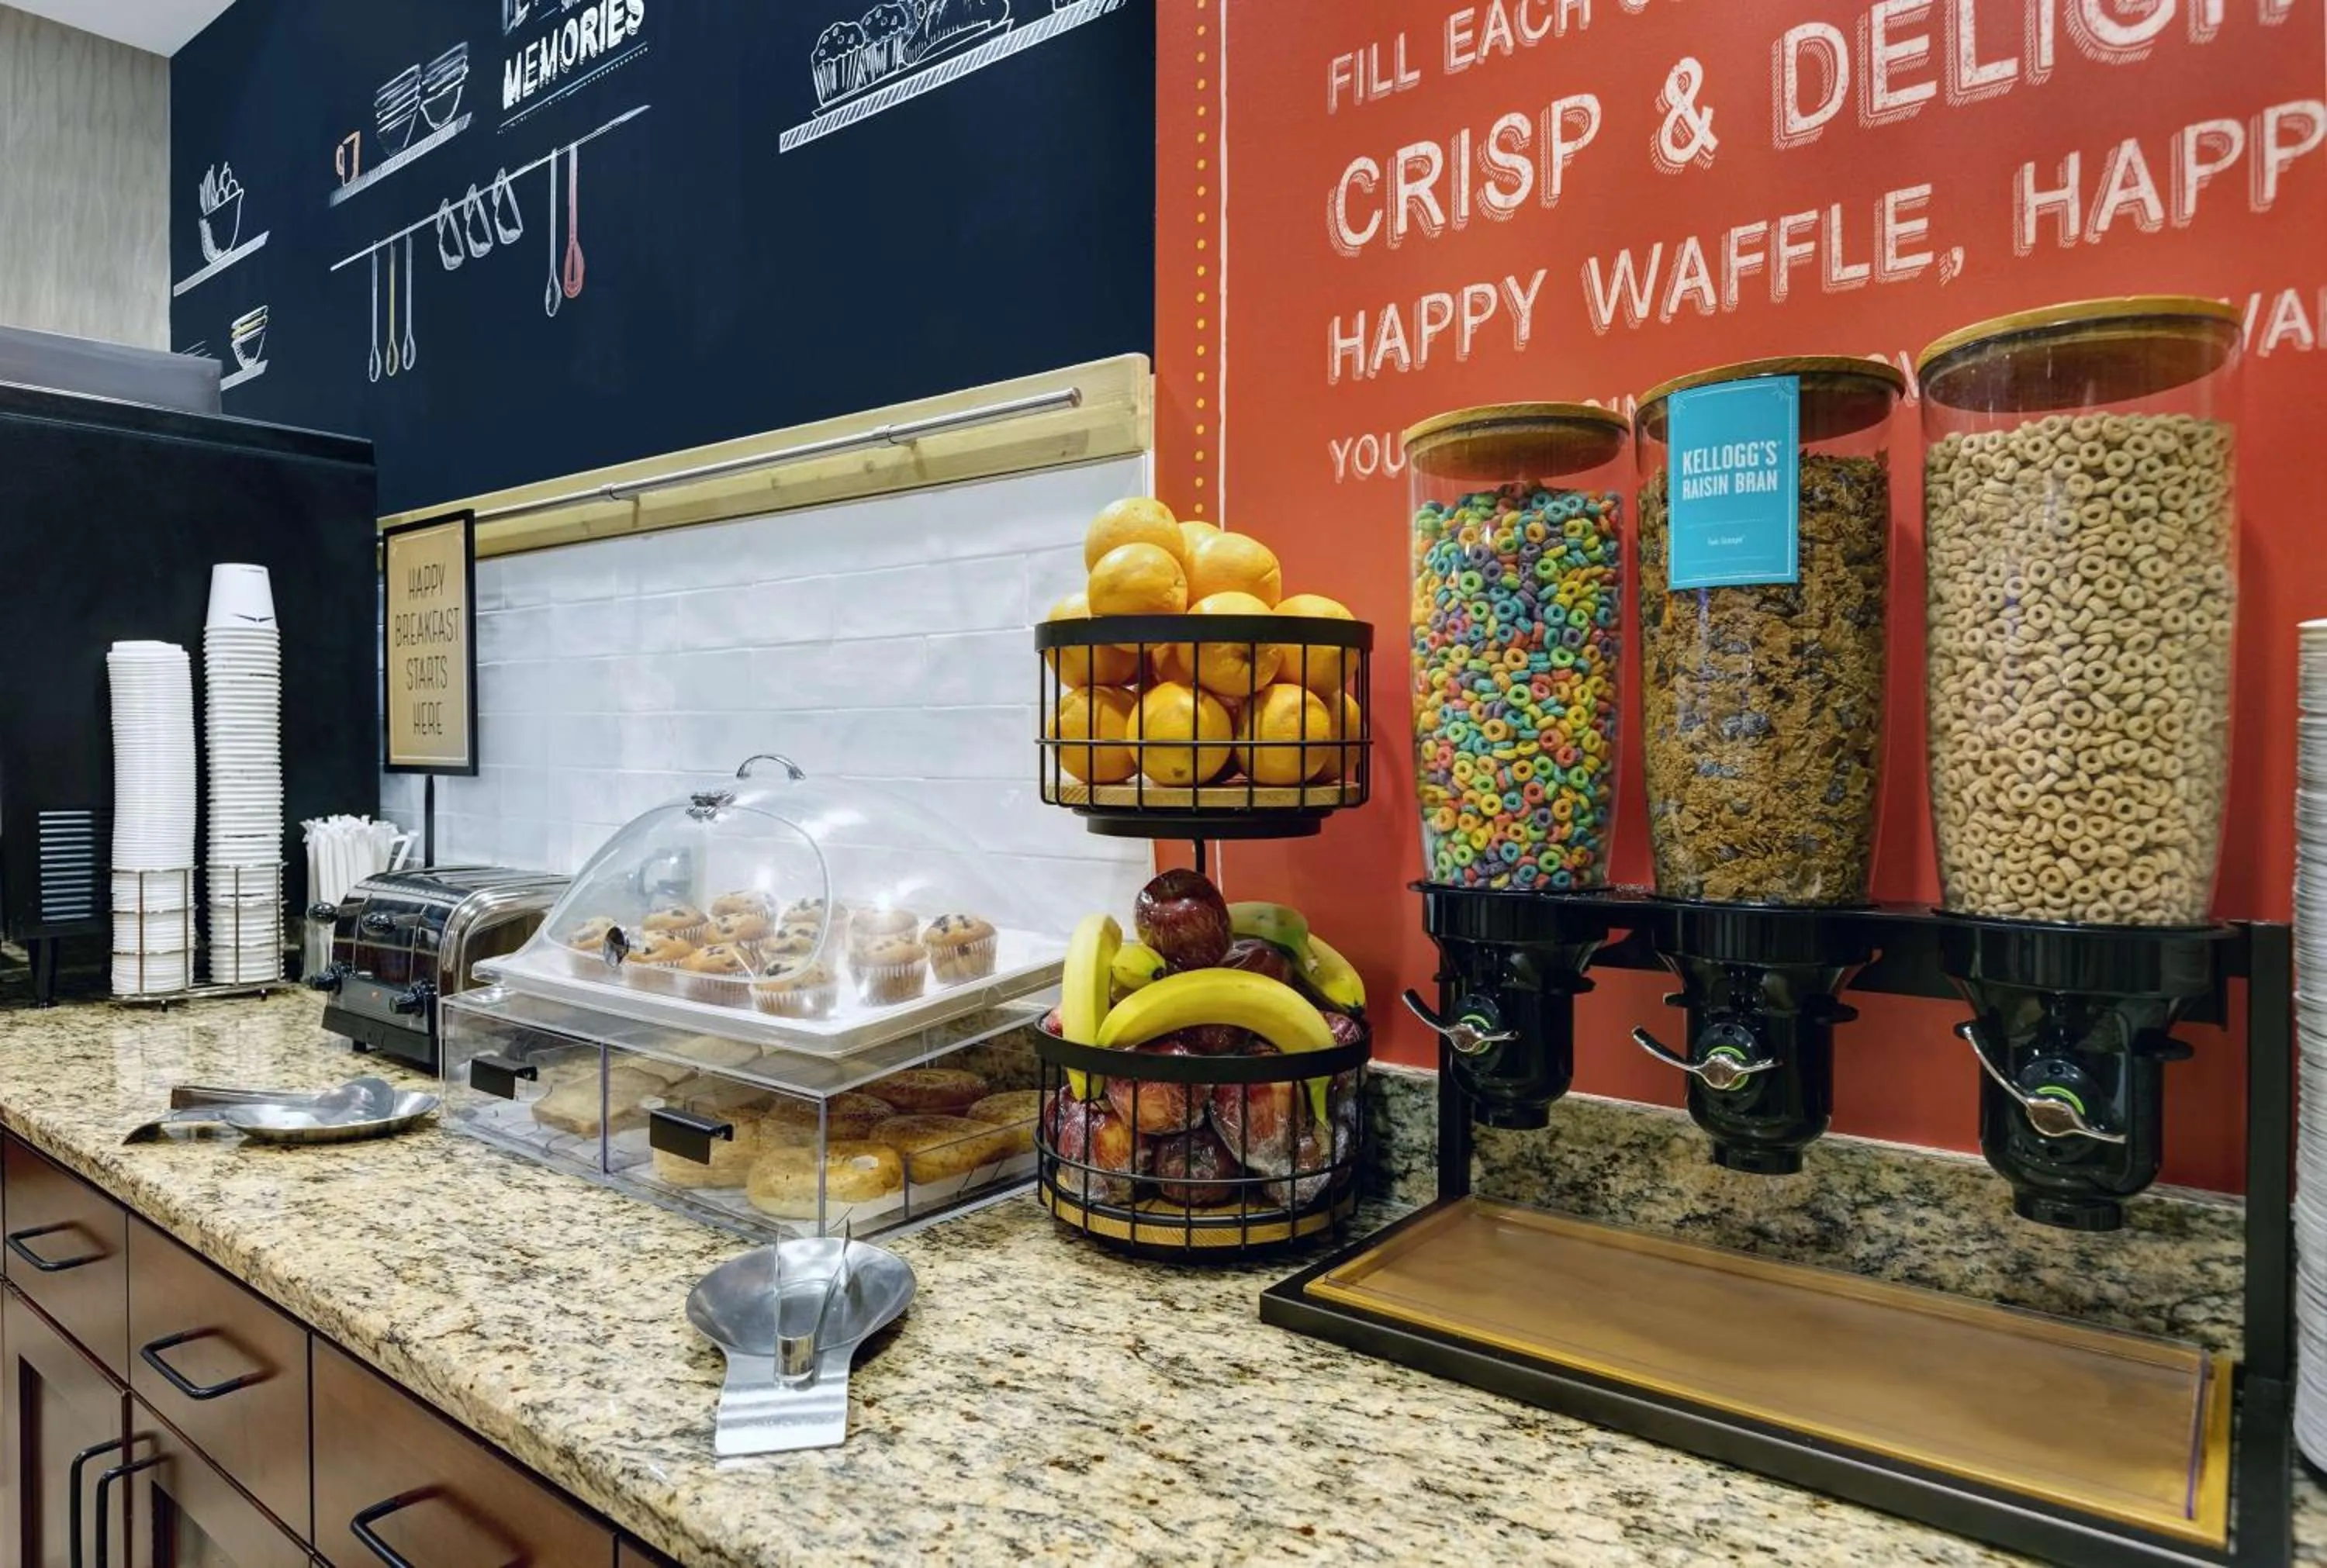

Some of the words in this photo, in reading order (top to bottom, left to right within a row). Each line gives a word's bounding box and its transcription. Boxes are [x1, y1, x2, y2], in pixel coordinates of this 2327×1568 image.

[503, 0, 645, 109] MEMORIES
[1328, 33, 1421, 114] FILL
[1444, 0, 1591, 74] EACH
[1328, 94, 1602, 257] CRISP
[1651, 57, 1719, 174] &
[1328, 268, 1548, 386] HAPPY
[1581, 184, 1966, 335] WAFFLE,
[2014, 98, 2327, 257] HAPP
[1682, 440, 1778, 475] KELLOGG'S
[1682, 473, 1729, 501] RAISIN
[1735, 469, 1778, 494] BRAN
[407, 561, 446, 601] HAPPY
[394, 607, 460, 648] BREAKFAST
[406, 654, 448, 691] STARTS
[413, 701, 443, 736] HERE
